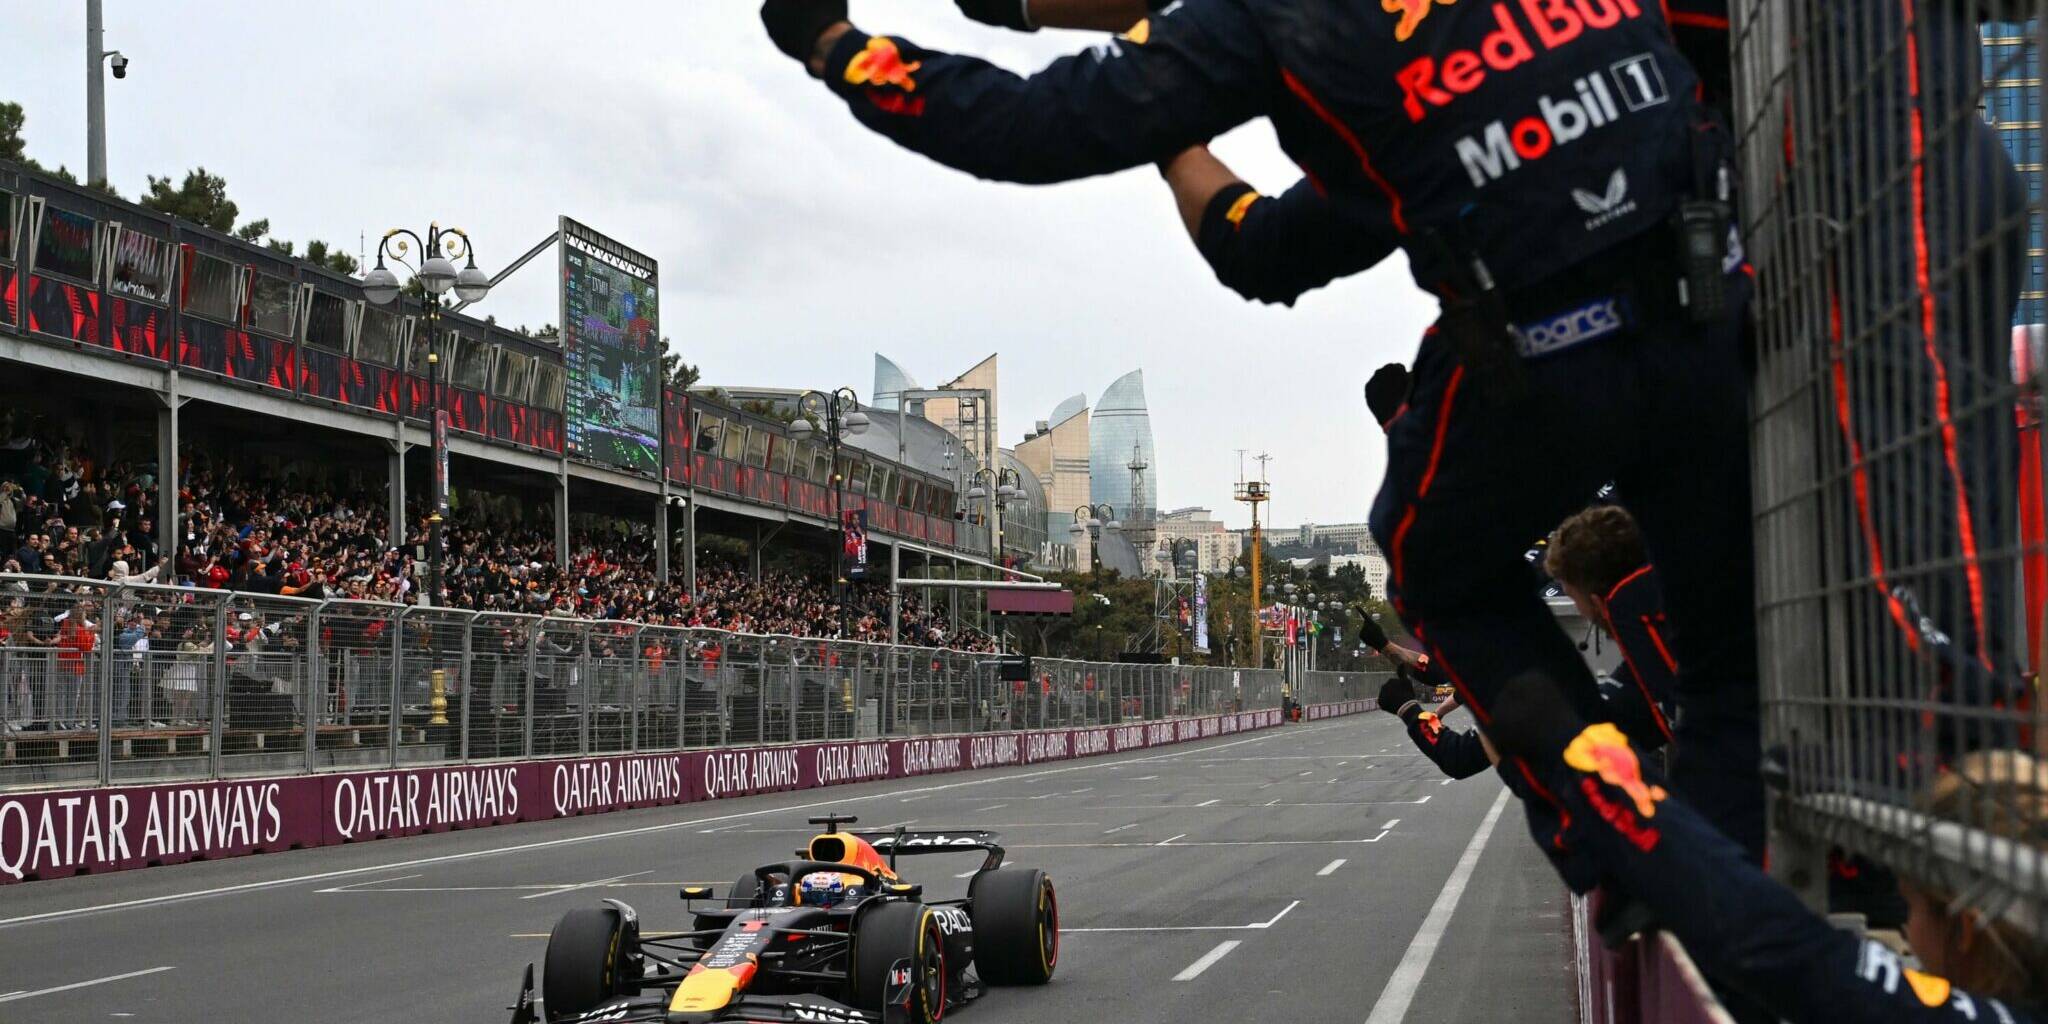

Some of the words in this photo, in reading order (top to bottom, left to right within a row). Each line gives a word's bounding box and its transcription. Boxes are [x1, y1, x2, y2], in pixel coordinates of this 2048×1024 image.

[1395, 4, 1535, 123] Red
[1514, 0, 1643, 50] Bu
[1454, 71, 1620, 188] Mobil
[553, 762, 611, 816] QATAR
[616, 757, 680, 804] AIRWAYS
[705, 753, 748, 798] QATAR
[750, 749, 799, 789] AIRWAYS
[816, 746, 849, 785] QATAR
[852, 743, 889, 778] AIRWAYS
[903, 740, 929, 775] QATAR
[931, 738, 961, 768] AIRWAYS
[0, 794, 131, 879] QATAR
[141, 783, 281, 857] AIRWAYS
[334, 775, 420, 838] QATAR
[426, 767, 518, 824] AIRWAYS
